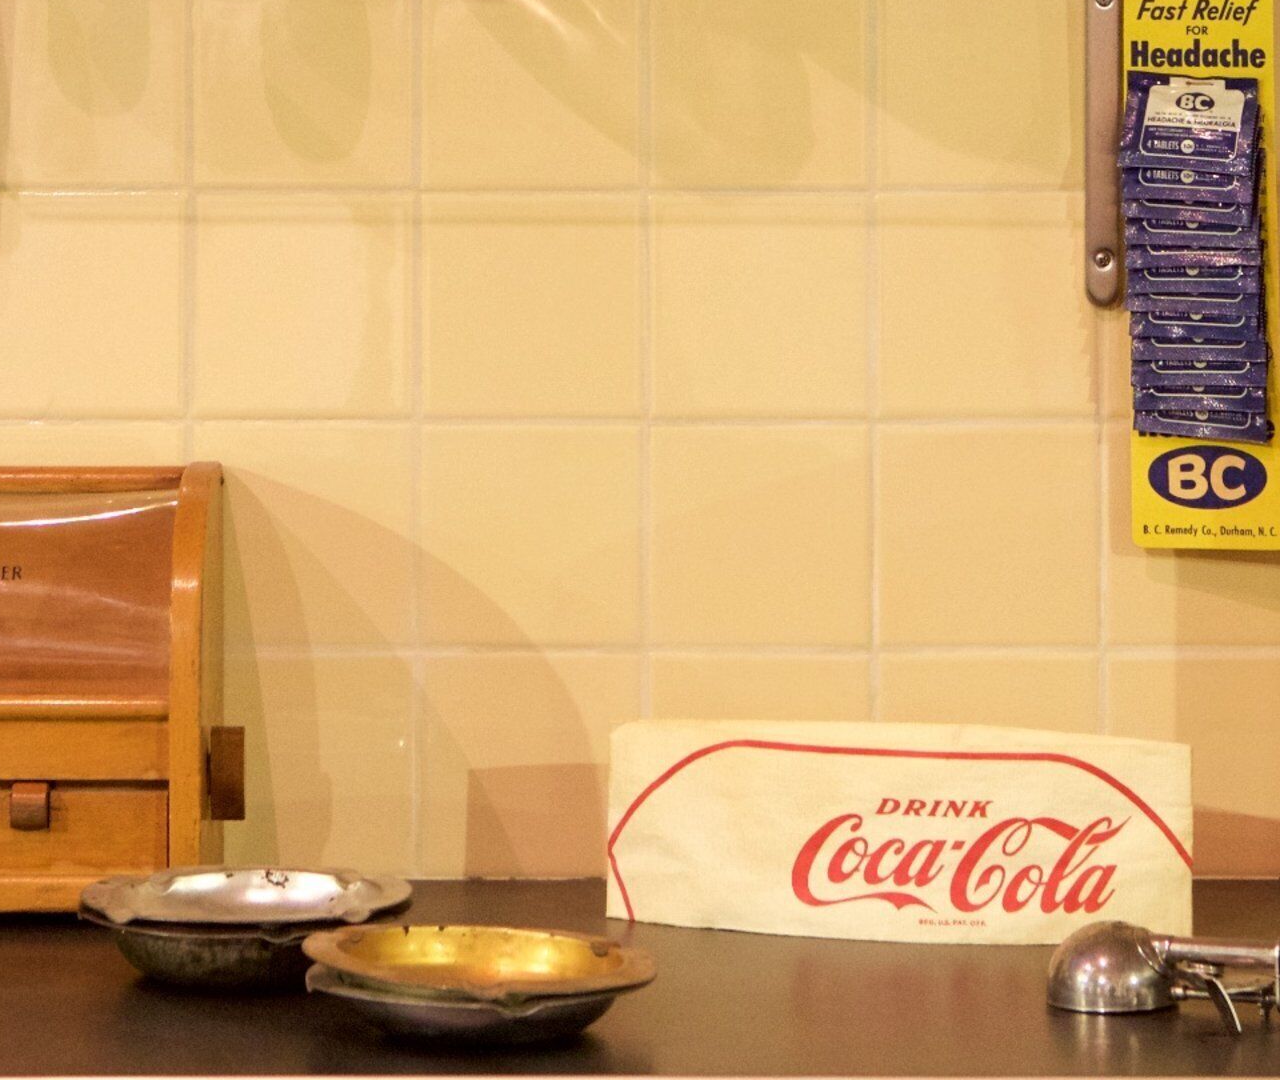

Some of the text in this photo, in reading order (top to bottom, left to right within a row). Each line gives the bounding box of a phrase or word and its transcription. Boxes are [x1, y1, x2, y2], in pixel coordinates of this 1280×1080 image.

[1186, 25, 1208, 35] FOR
[1130, 39, 1266, 68] Headache
[1180, 94, 1211, 110] BC
[1168, 453, 1247, 500] BC
[1165, 525, 1197, 537] Remedy
[1220, 526, 1256, 538] Durham,
[875, 798, 994, 819] DRINK
[791, 813, 1132, 914] Coca-Cola
